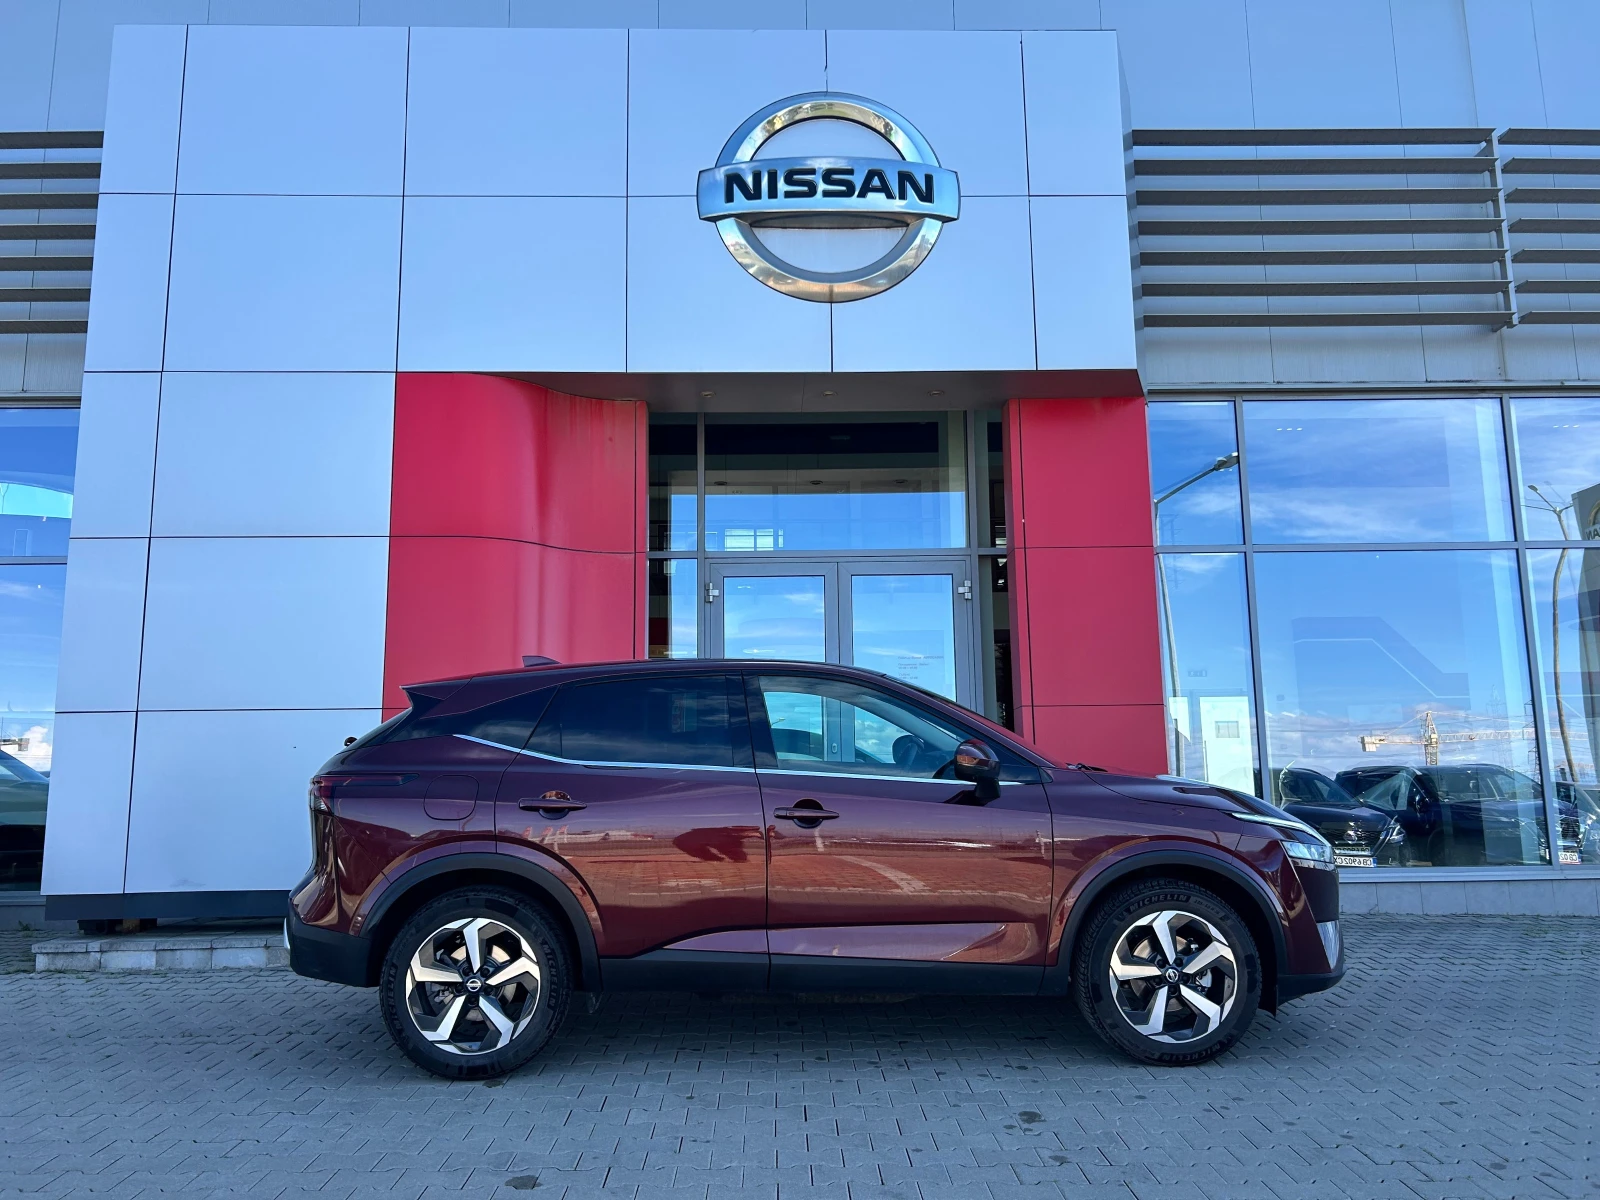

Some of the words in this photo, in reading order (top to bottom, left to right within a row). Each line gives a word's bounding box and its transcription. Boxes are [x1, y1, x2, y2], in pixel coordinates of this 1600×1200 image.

[724, 167, 934, 204] NISSAN
[1129, 894, 1188, 912] MICHELIN
[543, 944, 558, 1007] MICHELIN
[387, 966, 403, 1030] MICHELIN
[1162, 1043, 1220, 1061] MICHELIN
